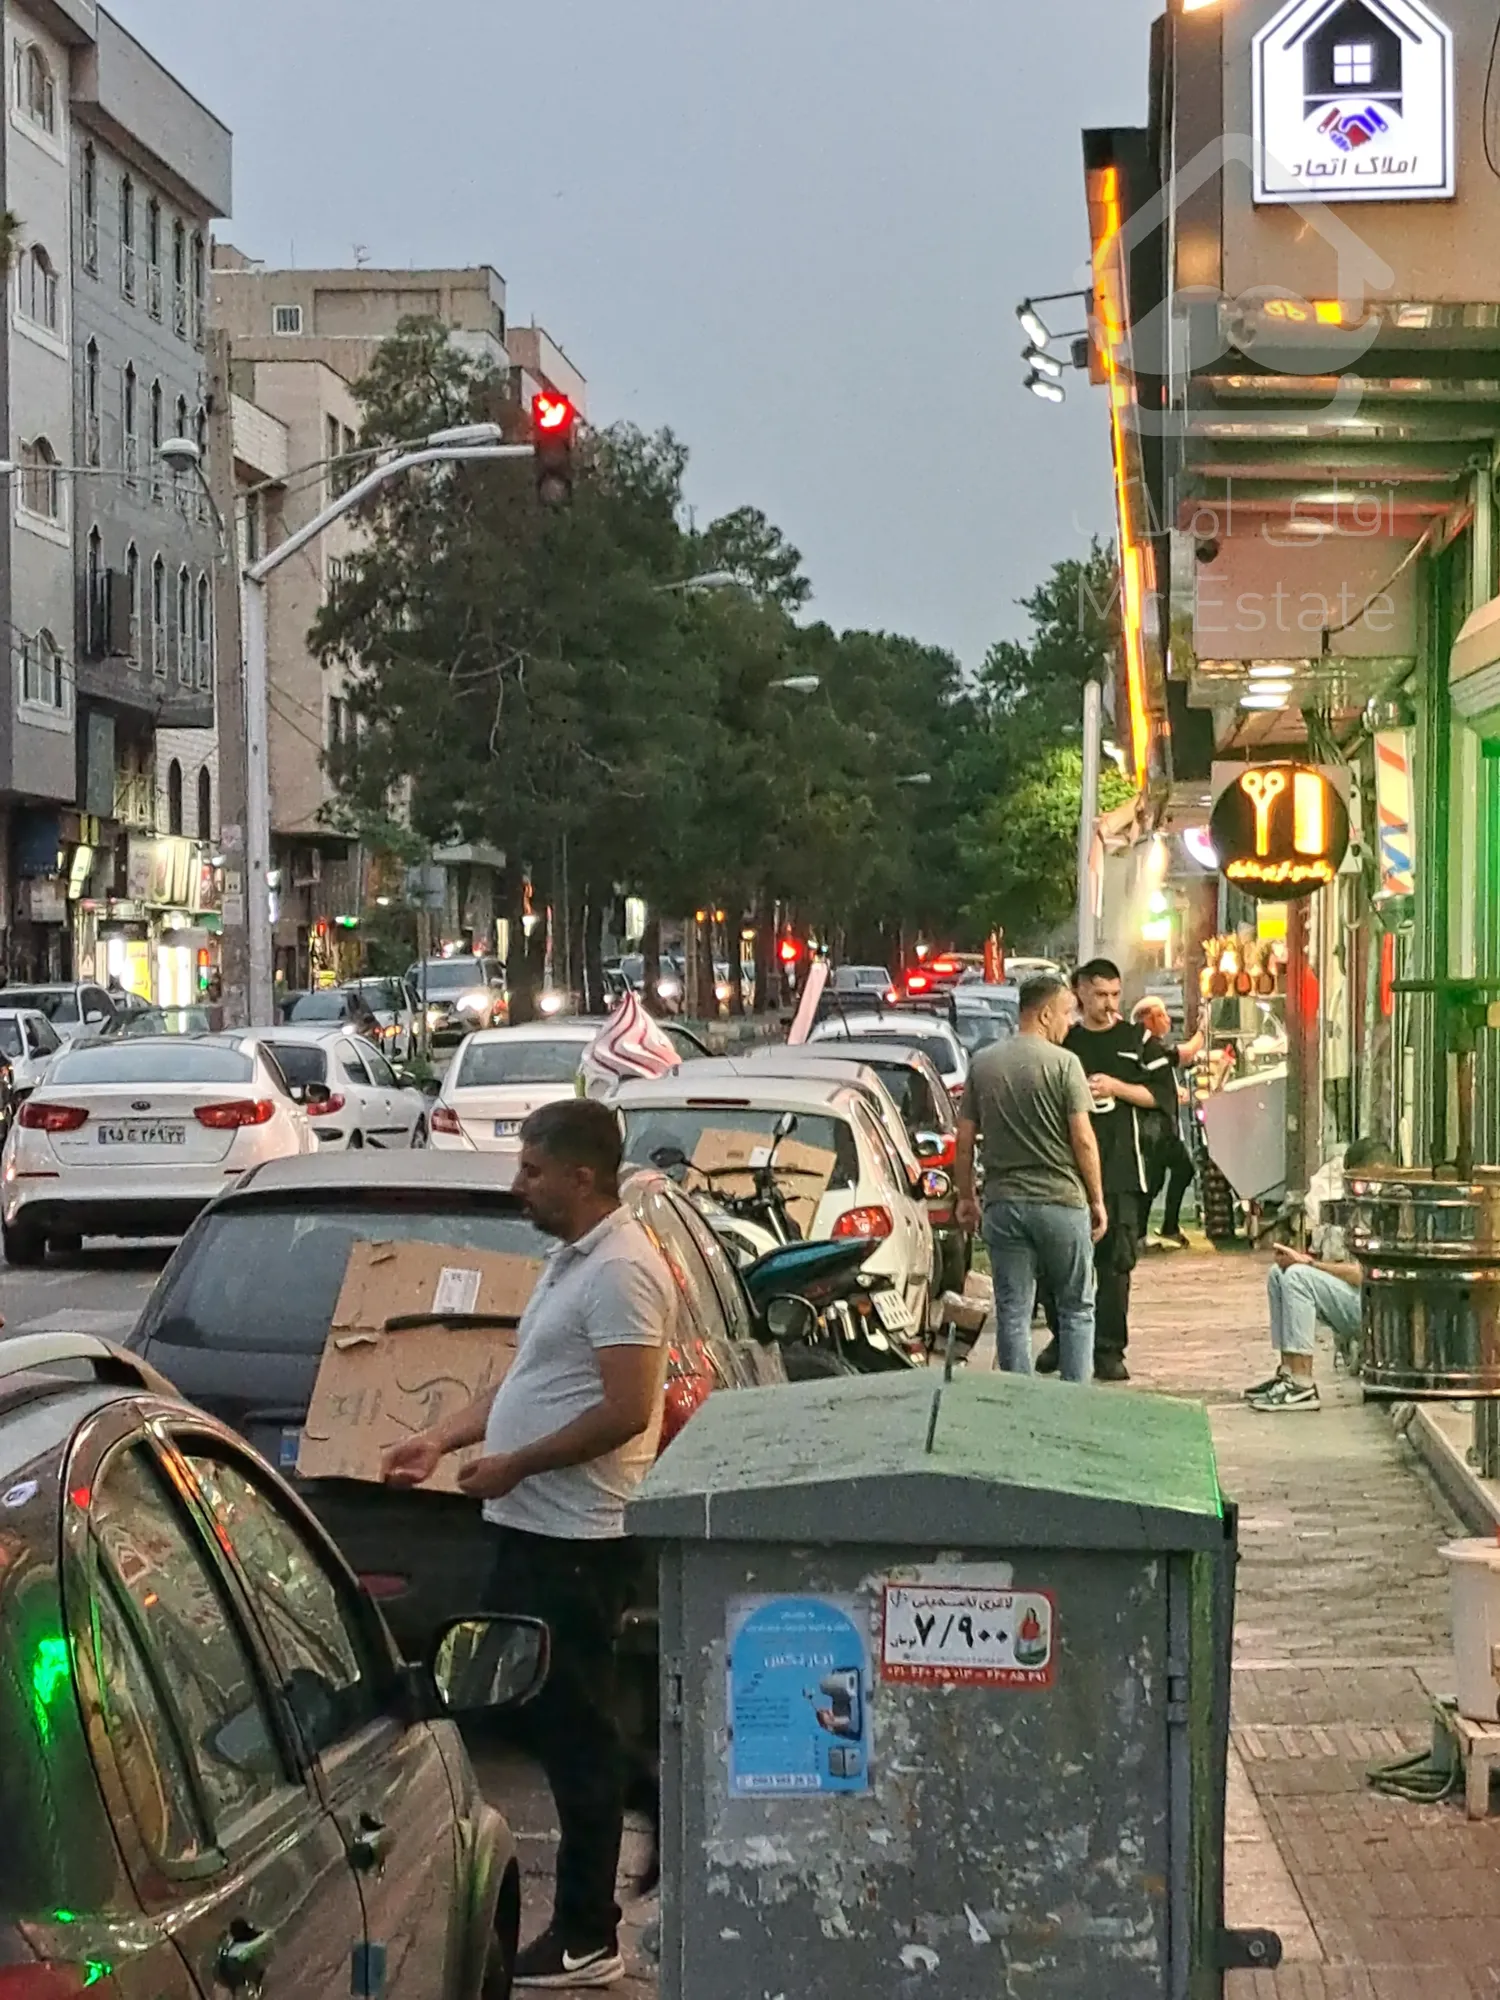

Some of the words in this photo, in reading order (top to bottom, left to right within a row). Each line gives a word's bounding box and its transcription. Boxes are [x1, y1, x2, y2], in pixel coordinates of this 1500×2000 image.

[1291, 157, 1347, 178] اتحاد
[1354, 156, 1418, 175] املاک
[914, 1612, 1008, 1648] ۷/۹۰۰
